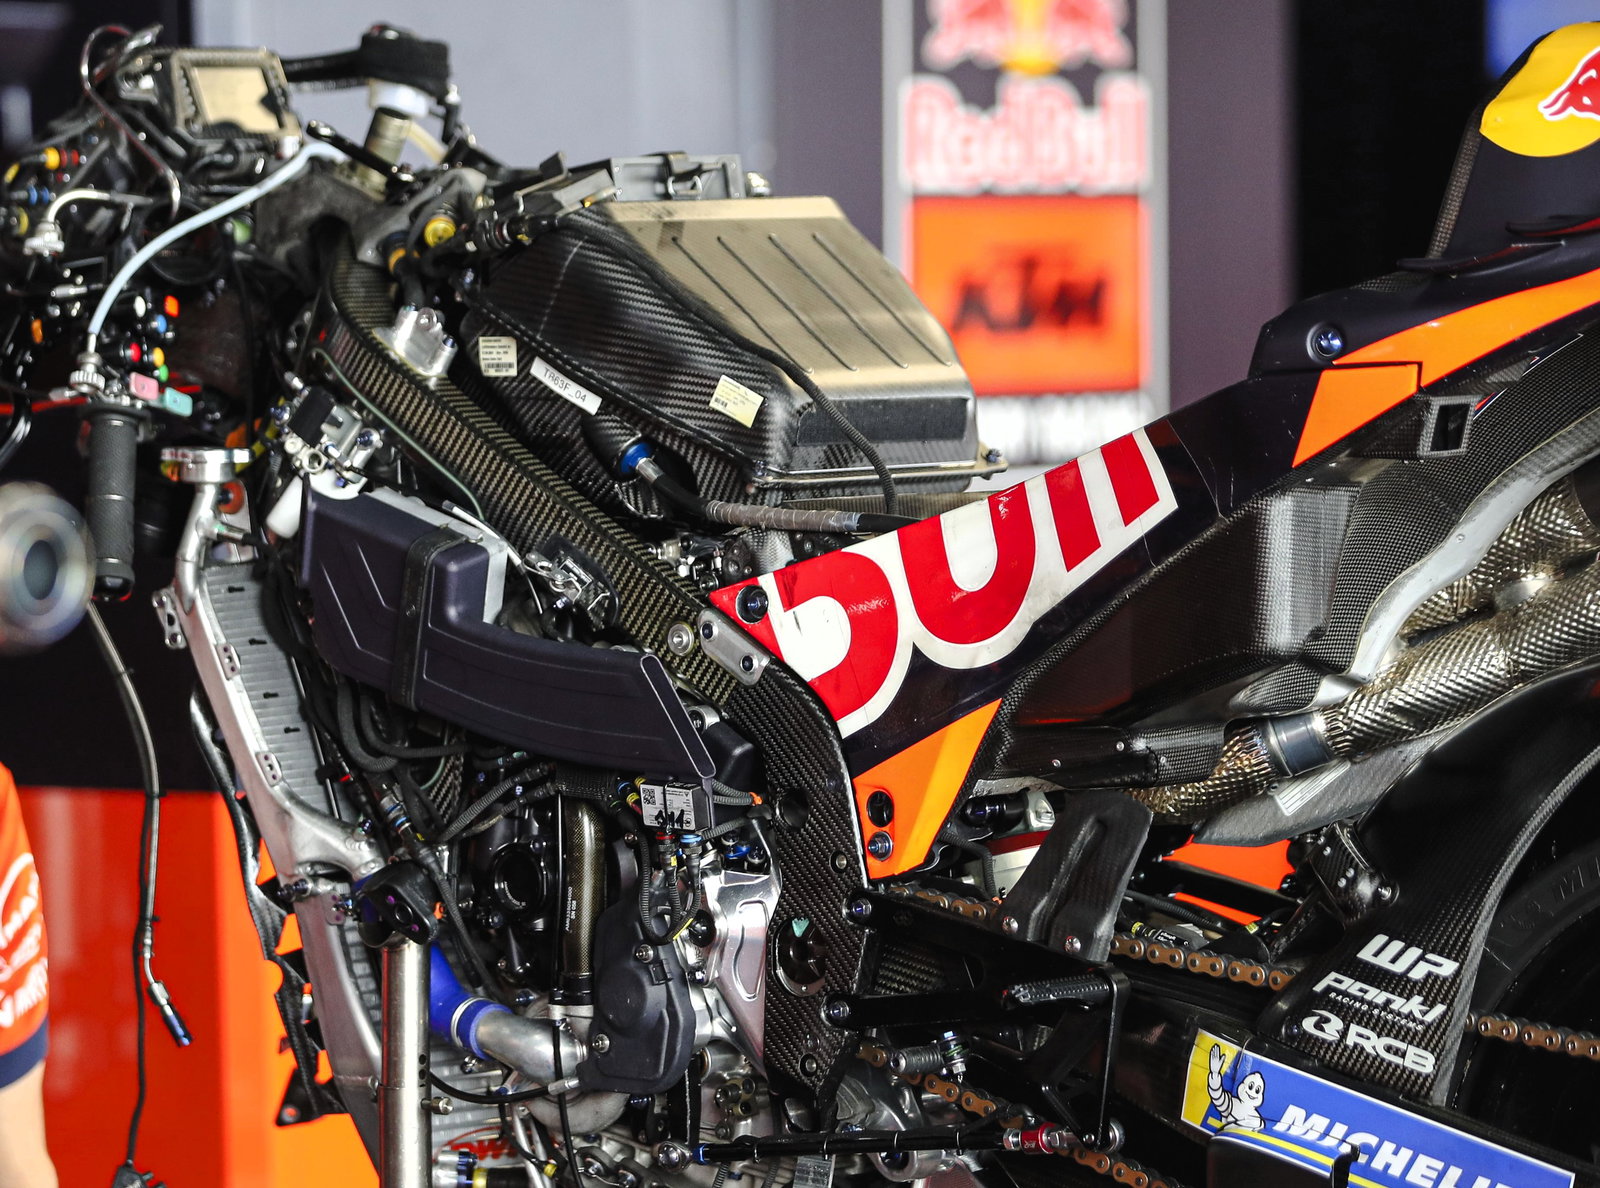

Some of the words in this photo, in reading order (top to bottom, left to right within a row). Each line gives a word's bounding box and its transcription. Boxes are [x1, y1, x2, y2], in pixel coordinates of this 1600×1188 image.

[1355, 933, 1460, 980] WP
[1328, 991, 1370, 1011] RACING
[1372, 1008, 1425, 1031] SYSTEMS
[1345, 1022, 1436, 1074] RCB
